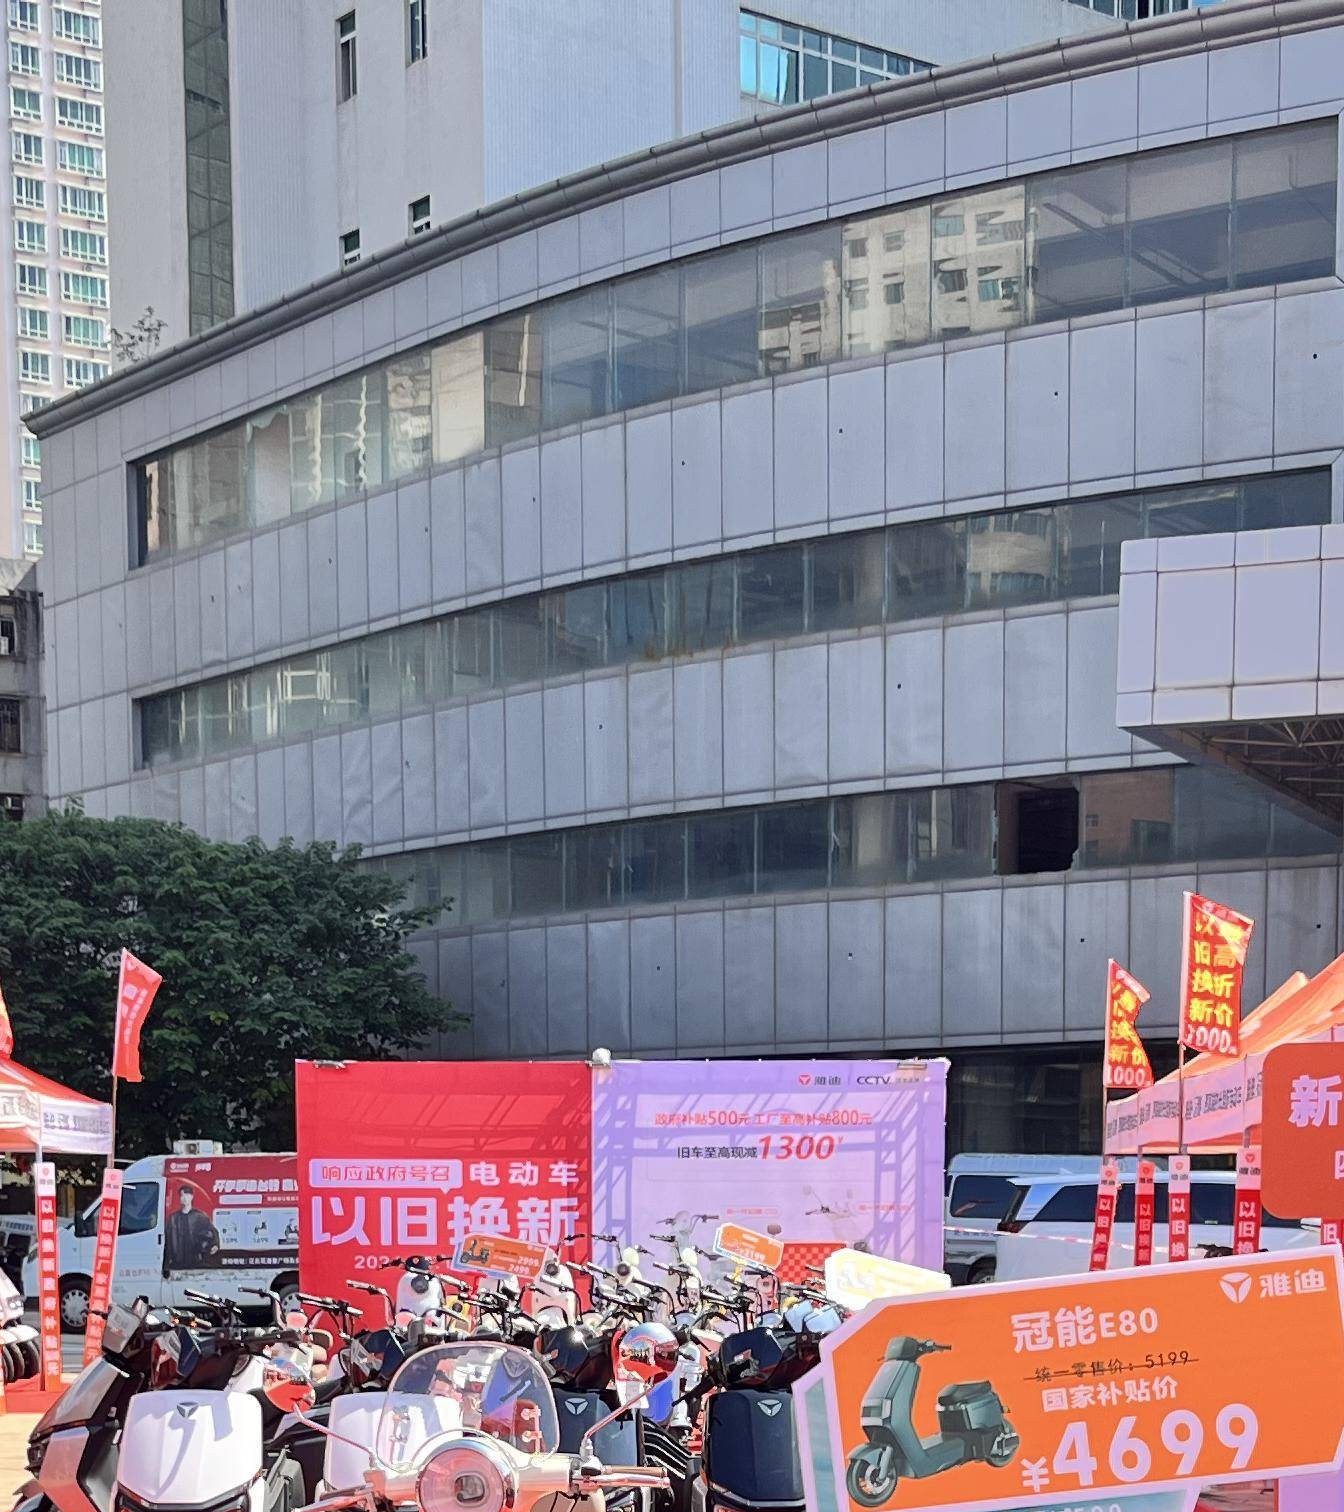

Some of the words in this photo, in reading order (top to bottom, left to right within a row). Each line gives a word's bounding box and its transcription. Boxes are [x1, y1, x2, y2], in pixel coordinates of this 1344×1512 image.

[856, 1075, 890, 1085] CCTV
[322, 1165, 450, 1182] 响应政府号召
[469, 1160, 580, 1186] 电动车
[1259, 1269, 1327, 1298] 雅迪
[1011, 1306, 1159, 1355] 冠能E80
[1041, 1375, 1179, 1413] 国家补贴价
